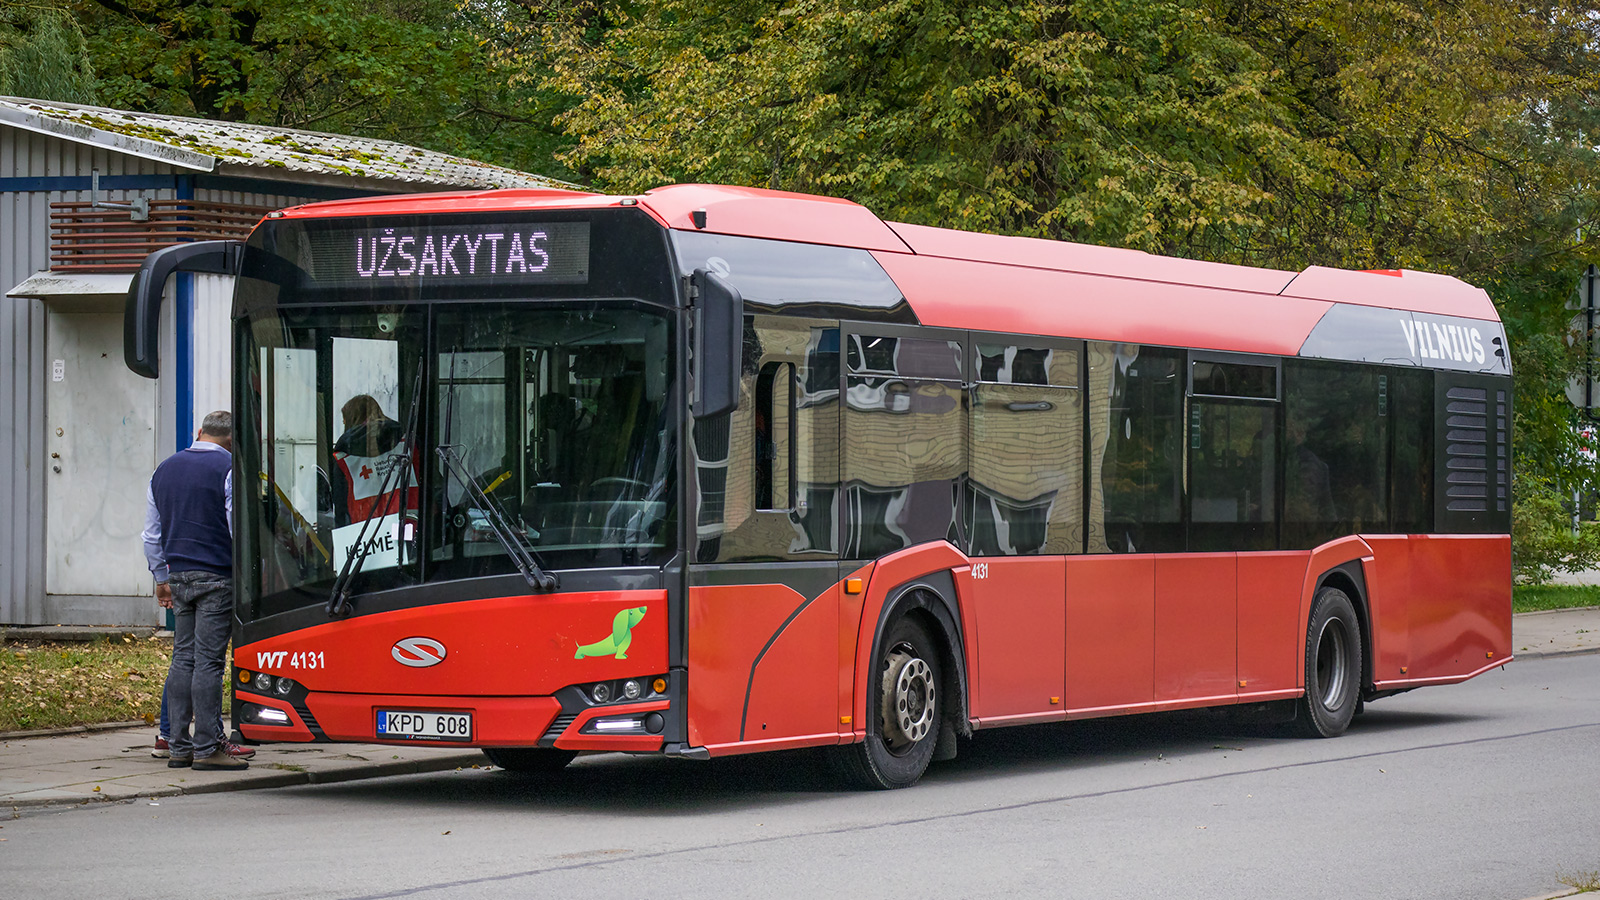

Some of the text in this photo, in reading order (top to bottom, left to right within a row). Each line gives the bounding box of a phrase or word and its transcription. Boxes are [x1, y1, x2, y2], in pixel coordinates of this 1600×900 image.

[357, 228, 549, 277] UŽSAKYTAS
[1400, 319, 1486, 364] VILNIUS
[345, 531, 394, 560] KELMĖ
[971, 563, 989, 579] 4131
[290, 651, 325, 669] 4131
[388, 713, 467, 735] KPD 608
